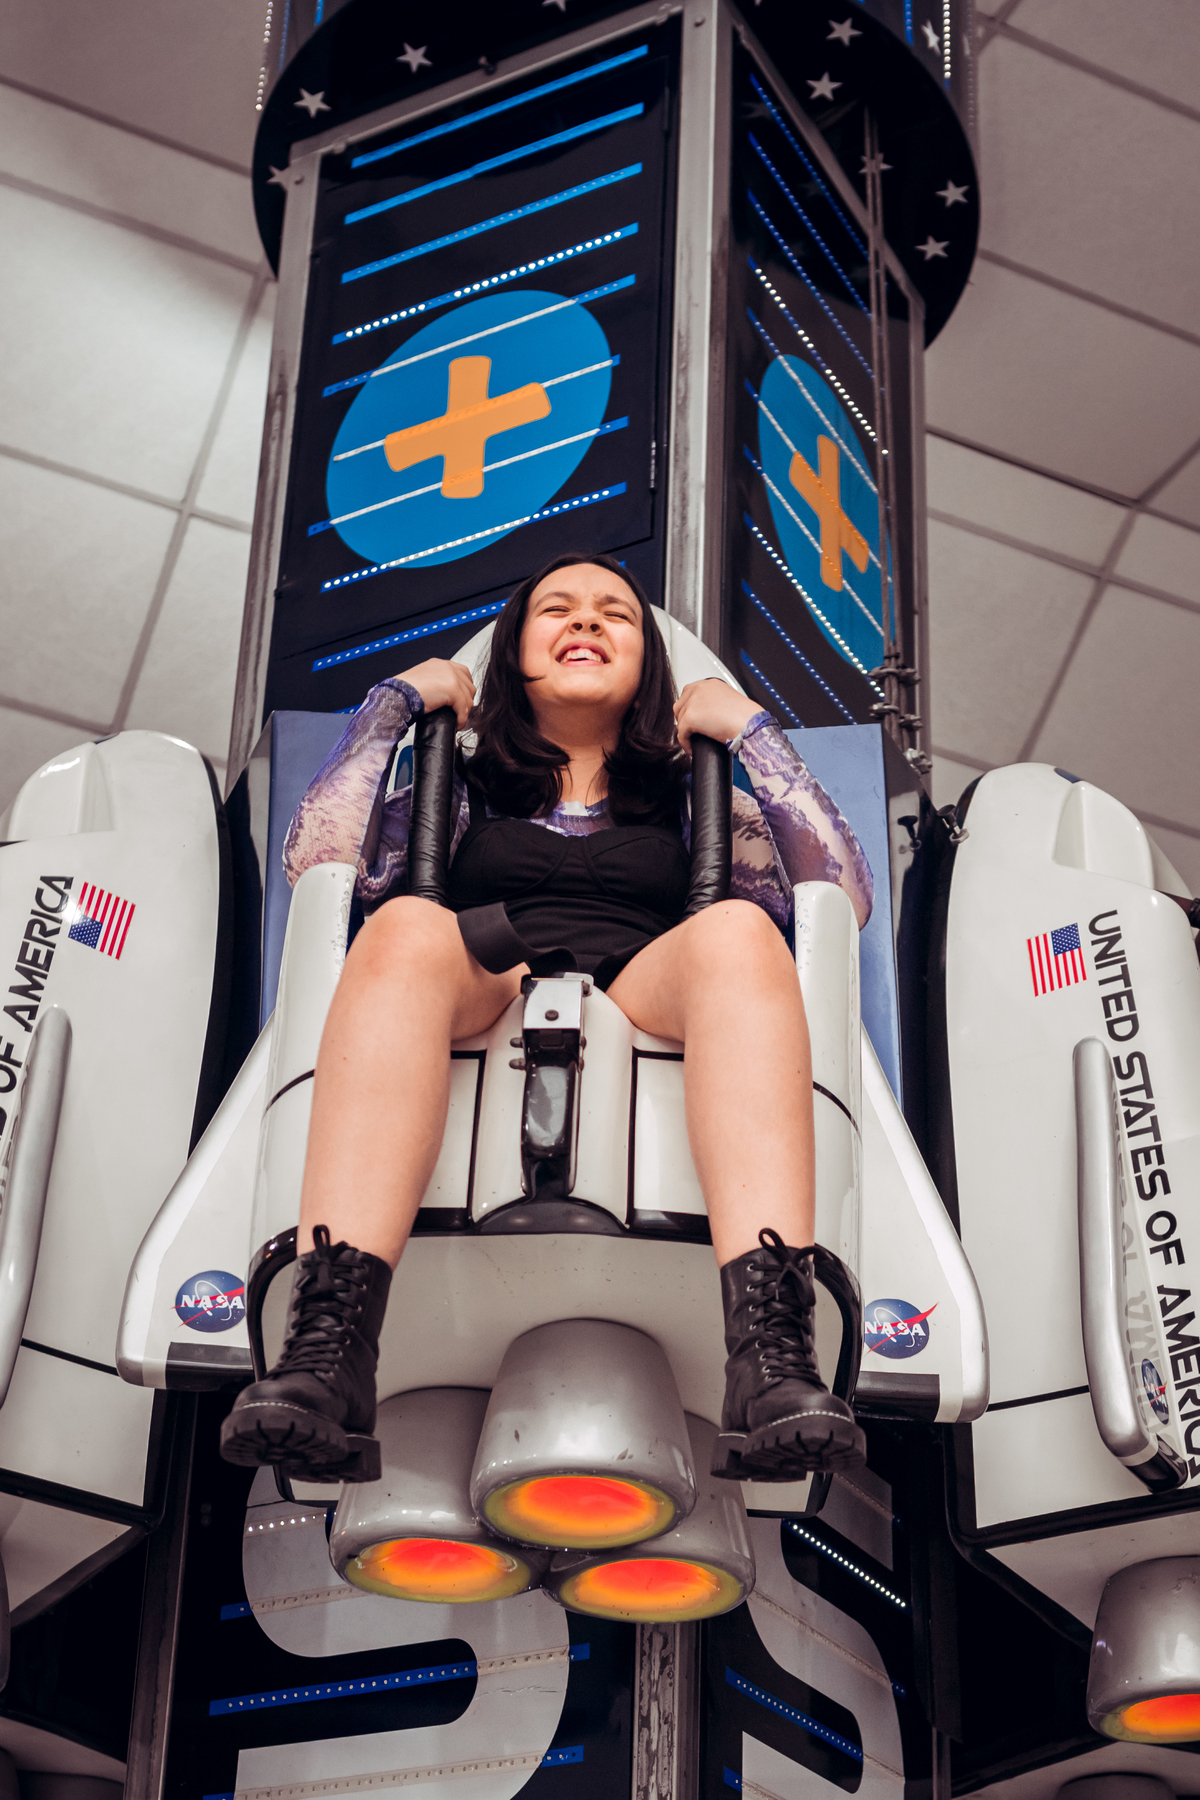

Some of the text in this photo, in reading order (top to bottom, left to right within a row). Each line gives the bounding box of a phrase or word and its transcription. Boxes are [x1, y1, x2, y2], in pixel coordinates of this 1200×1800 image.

[3, 876, 74, 1033] AMERICA
[1089, 909, 1140, 1042] UNITED
[1112, 1051, 1172, 1201] STATES
[1146, 1210, 1186, 1266] OF
[180, 1294, 245, 1310] NASA
[865, 1321, 926, 1337] NASA
